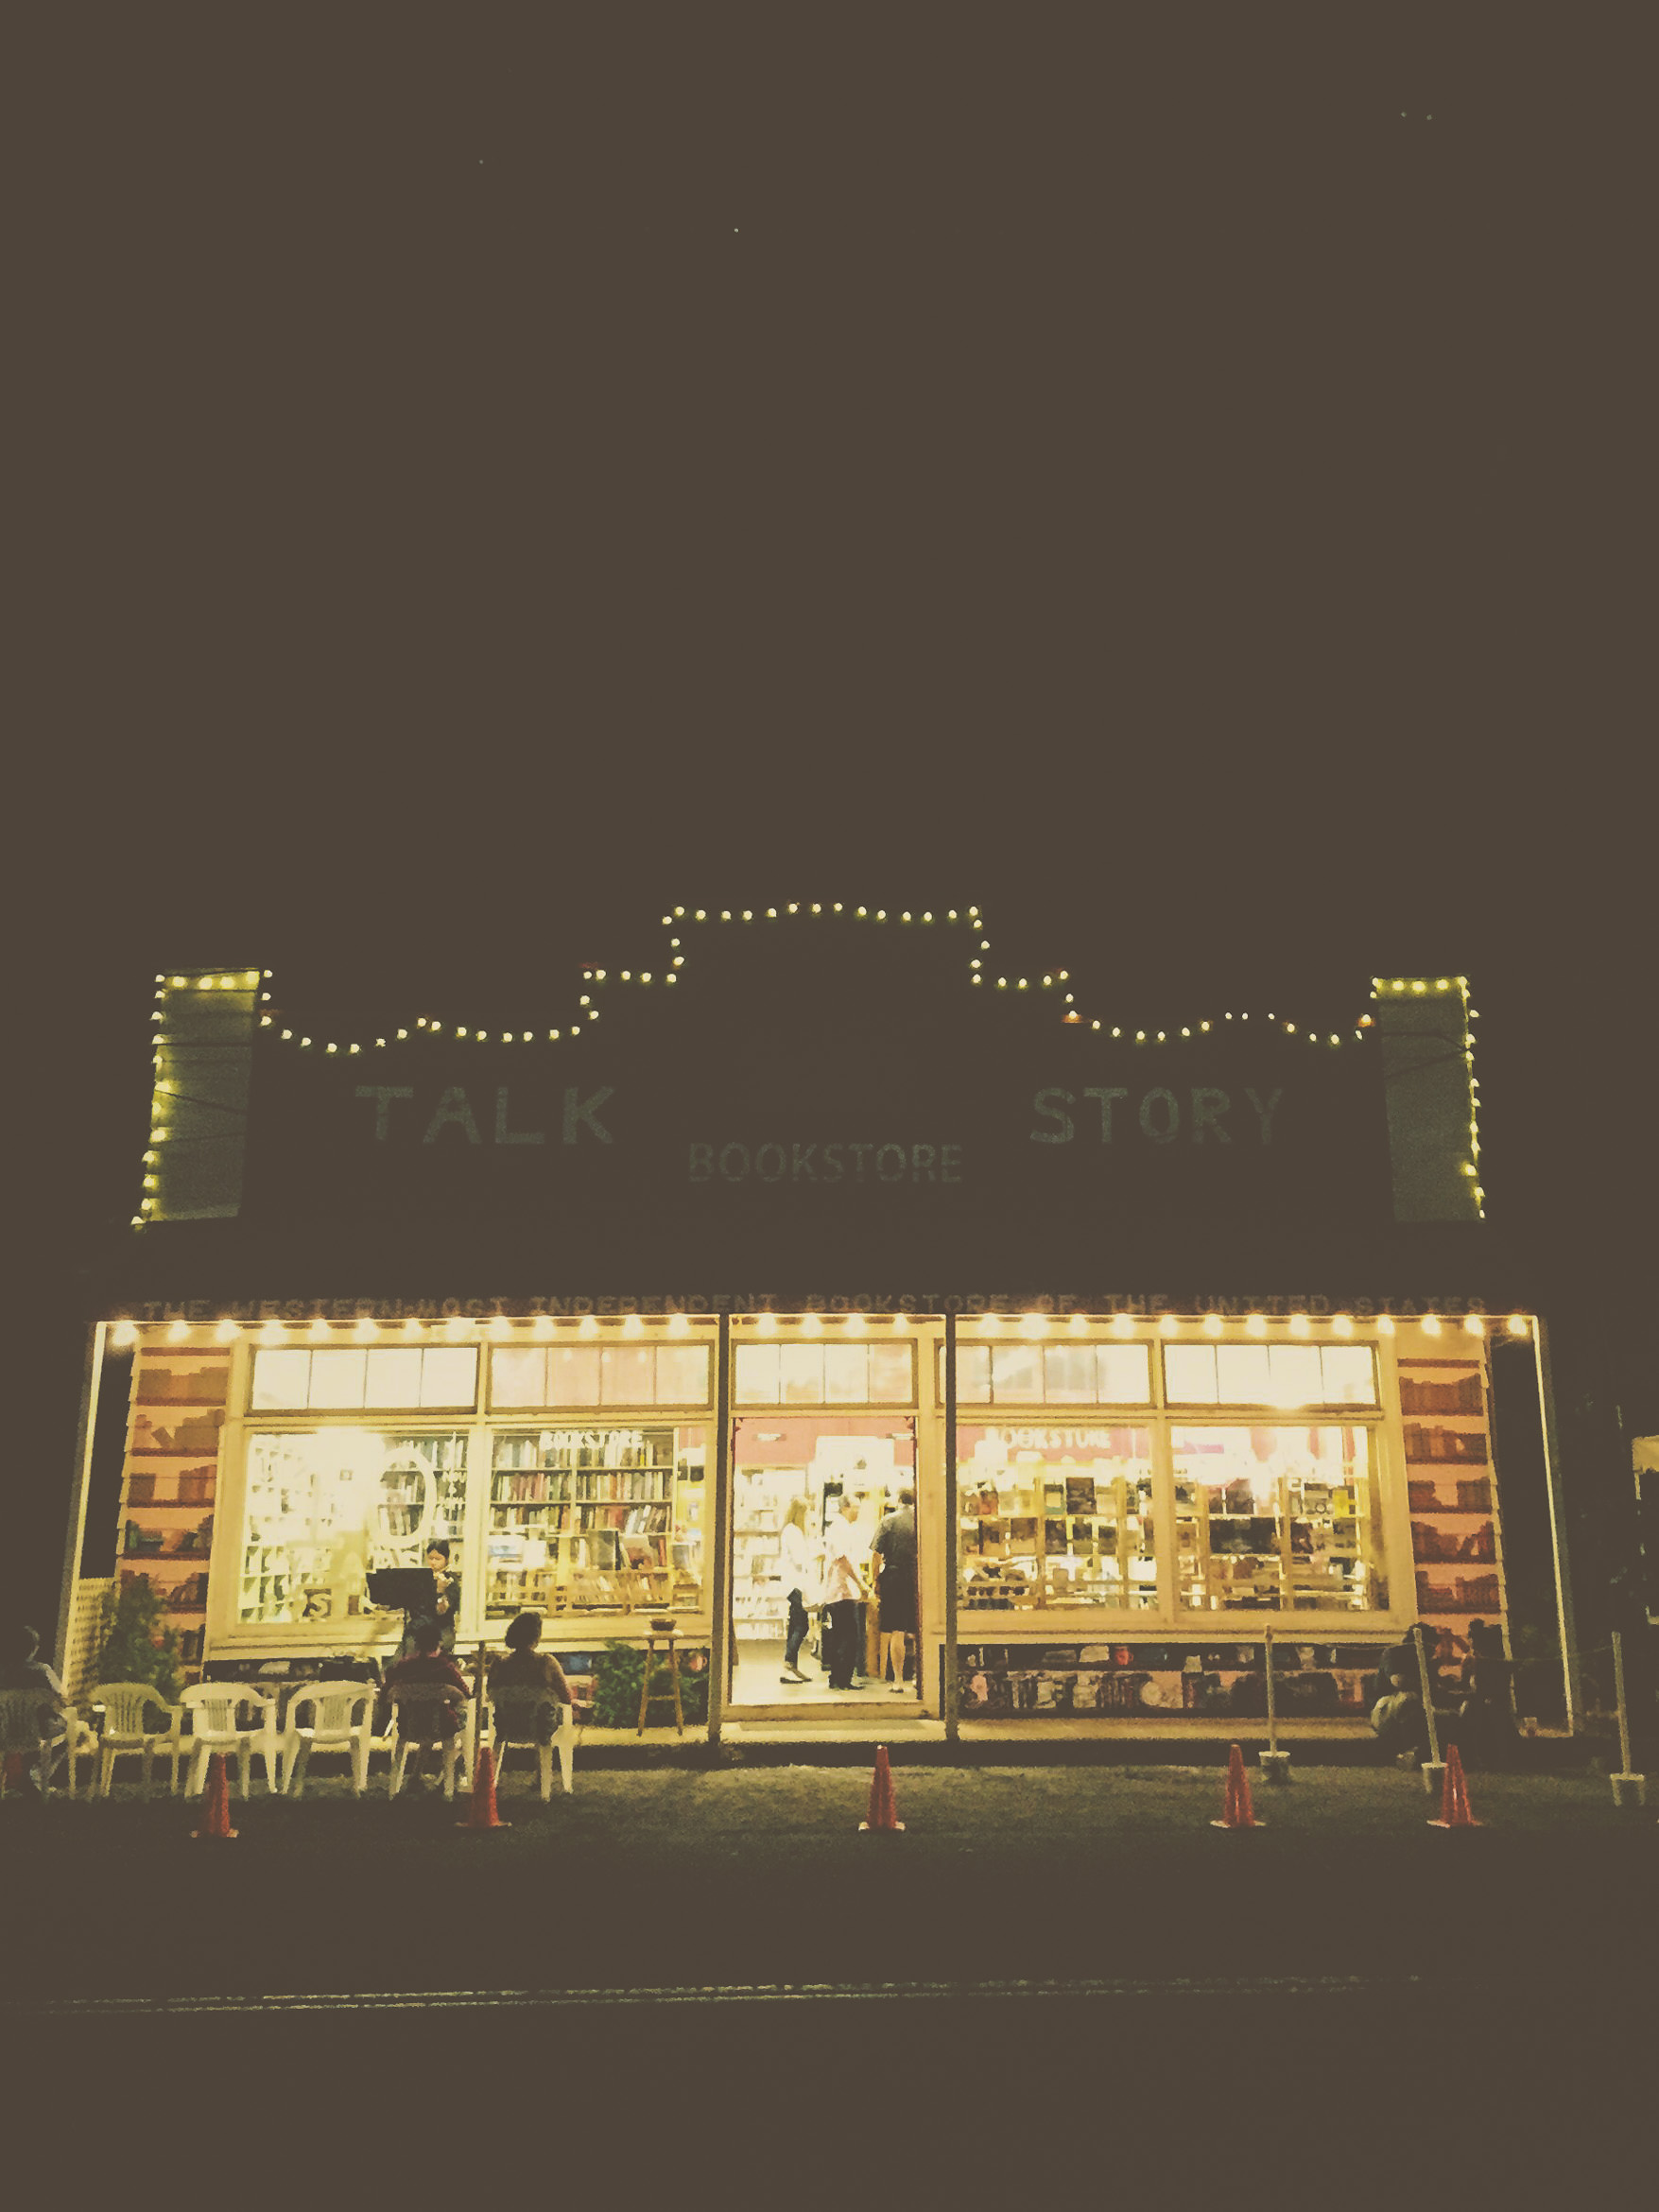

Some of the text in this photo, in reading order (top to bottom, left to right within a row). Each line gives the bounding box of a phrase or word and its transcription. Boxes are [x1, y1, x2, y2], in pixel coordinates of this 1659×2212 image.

[354, 1086, 1284, 1145] TALK STORY
[689, 1141, 962, 1184] BOOKSTORE
[144, 1300, 211, 1320] THE
[530, 1293, 776, 1316] INDEPENDENT
[805, 1294, 1009, 1314] BOOKSTORE
[1103, 1294, 1168, 1314] THE
[1194, 1294, 1329, 1315] UNITED
